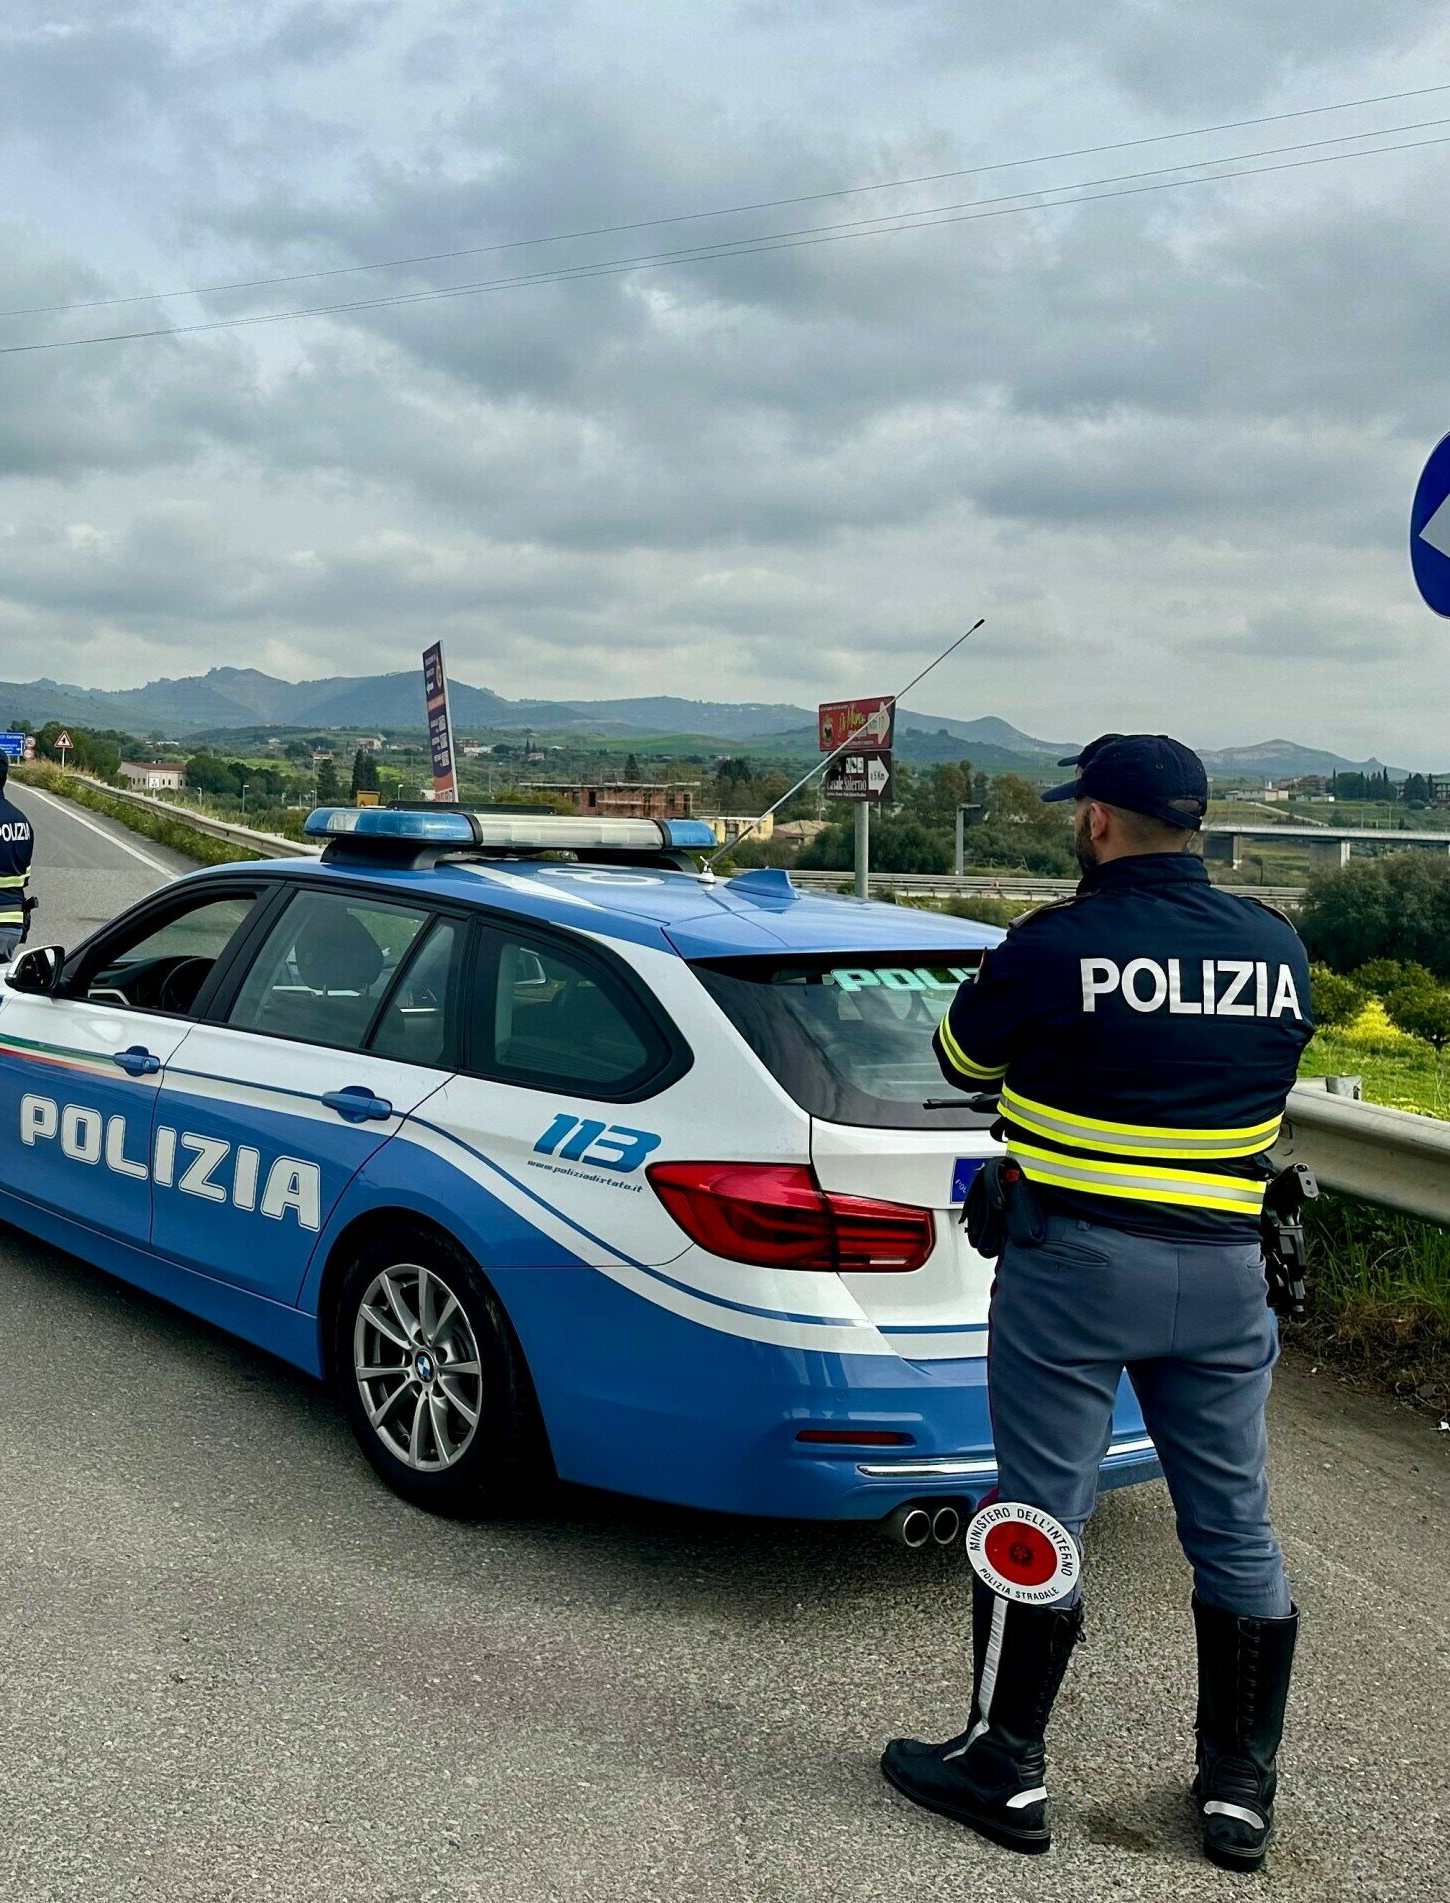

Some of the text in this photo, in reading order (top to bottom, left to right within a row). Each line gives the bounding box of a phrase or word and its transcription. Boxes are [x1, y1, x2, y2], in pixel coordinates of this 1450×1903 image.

[843, 775, 867, 791] Salerno
[1080, 957, 1303, 1020] POLIZIA
[20, 1093, 321, 1232] POLIZIA
[533, 1113, 662, 1173] 113
[527, 1160, 644, 1194] www.poliziadistato.it
[969, 1507, 1074, 1577] MINISTERO DELL'INTERNO
[979, 1568, 1060, 1600] POLIZIA STRADALE
